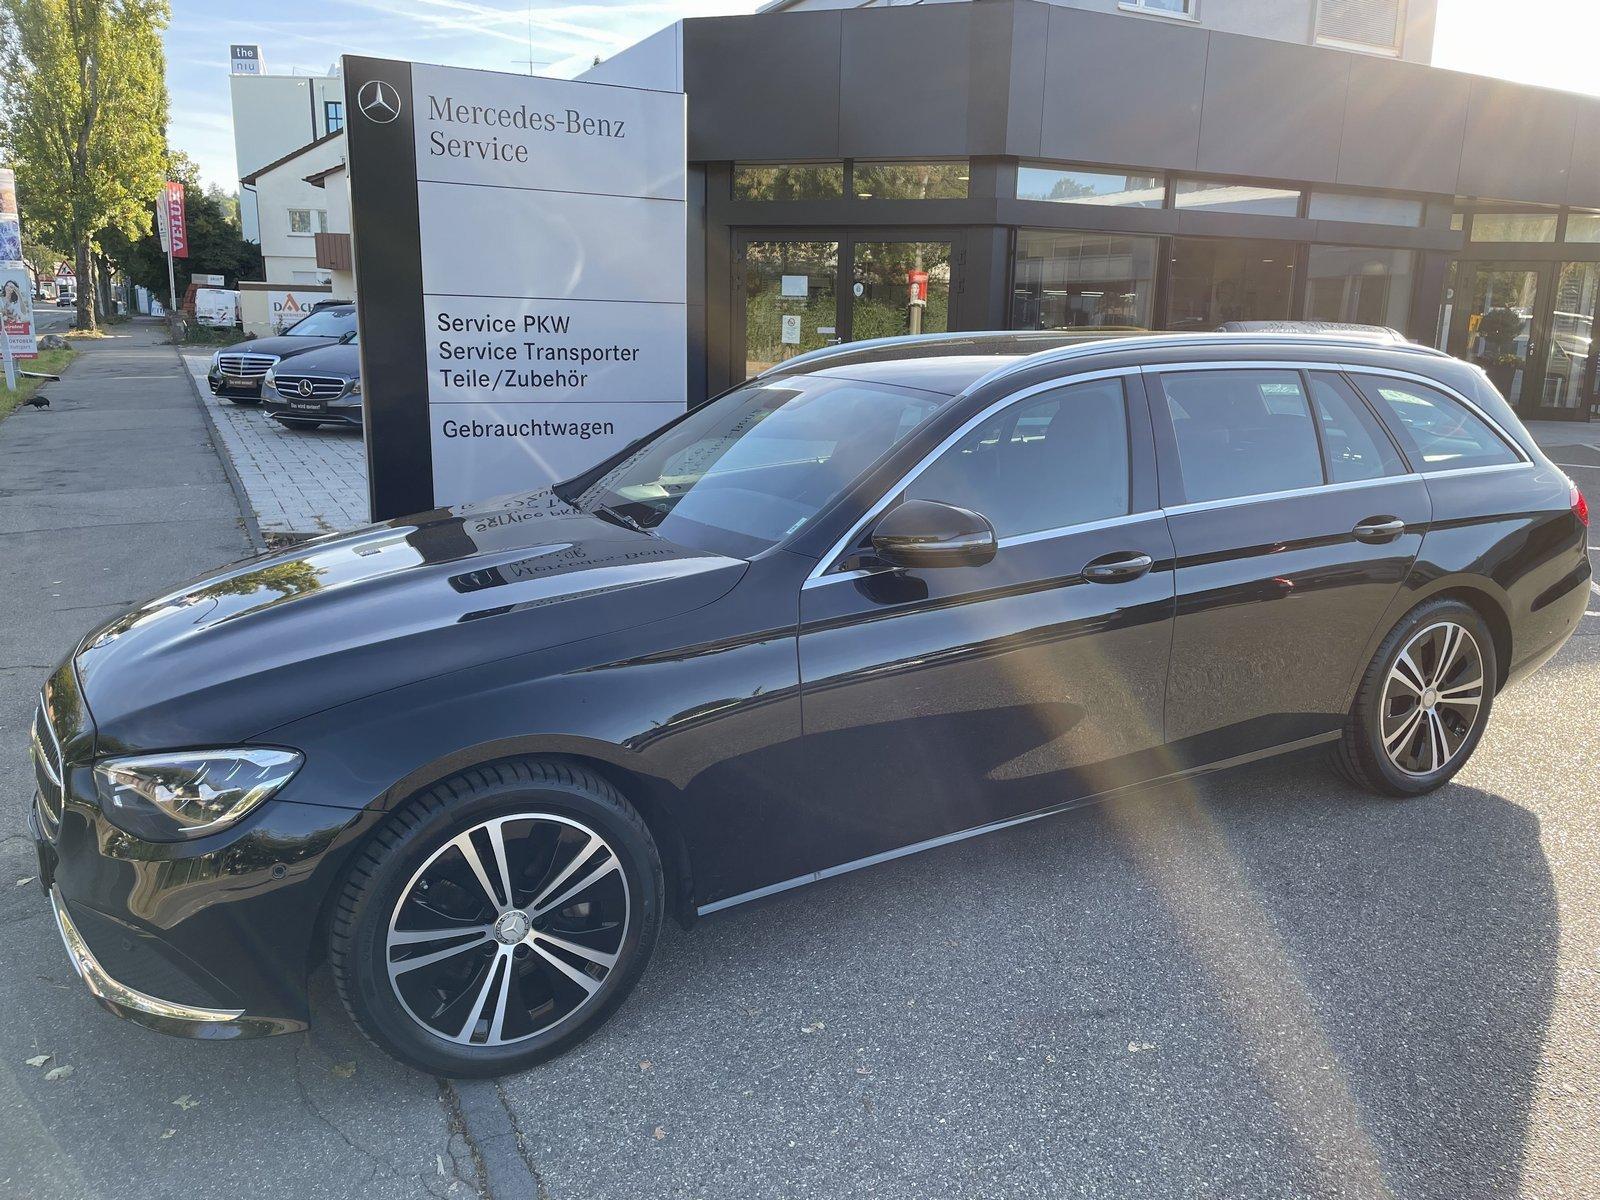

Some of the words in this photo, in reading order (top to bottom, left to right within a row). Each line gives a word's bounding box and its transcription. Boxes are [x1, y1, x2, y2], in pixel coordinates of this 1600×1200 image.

[236, 47, 254, 58] the
[236, 62, 255, 71] niu
[428, 95, 626, 139] Mercedes-Benz
[430, 130, 529, 163] Service
[169, 190, 185, 252] VELUX
[437, 312, 516, 333] Service
[523, 314, 571, 334] PKW
[439, 340, 518, 361] Service
[523, 342, 640, 366] Transporter
[439, 368, 588, 392] Teile/Zubehör
[442, 418, 614, 440] Gebrauchtwagen
